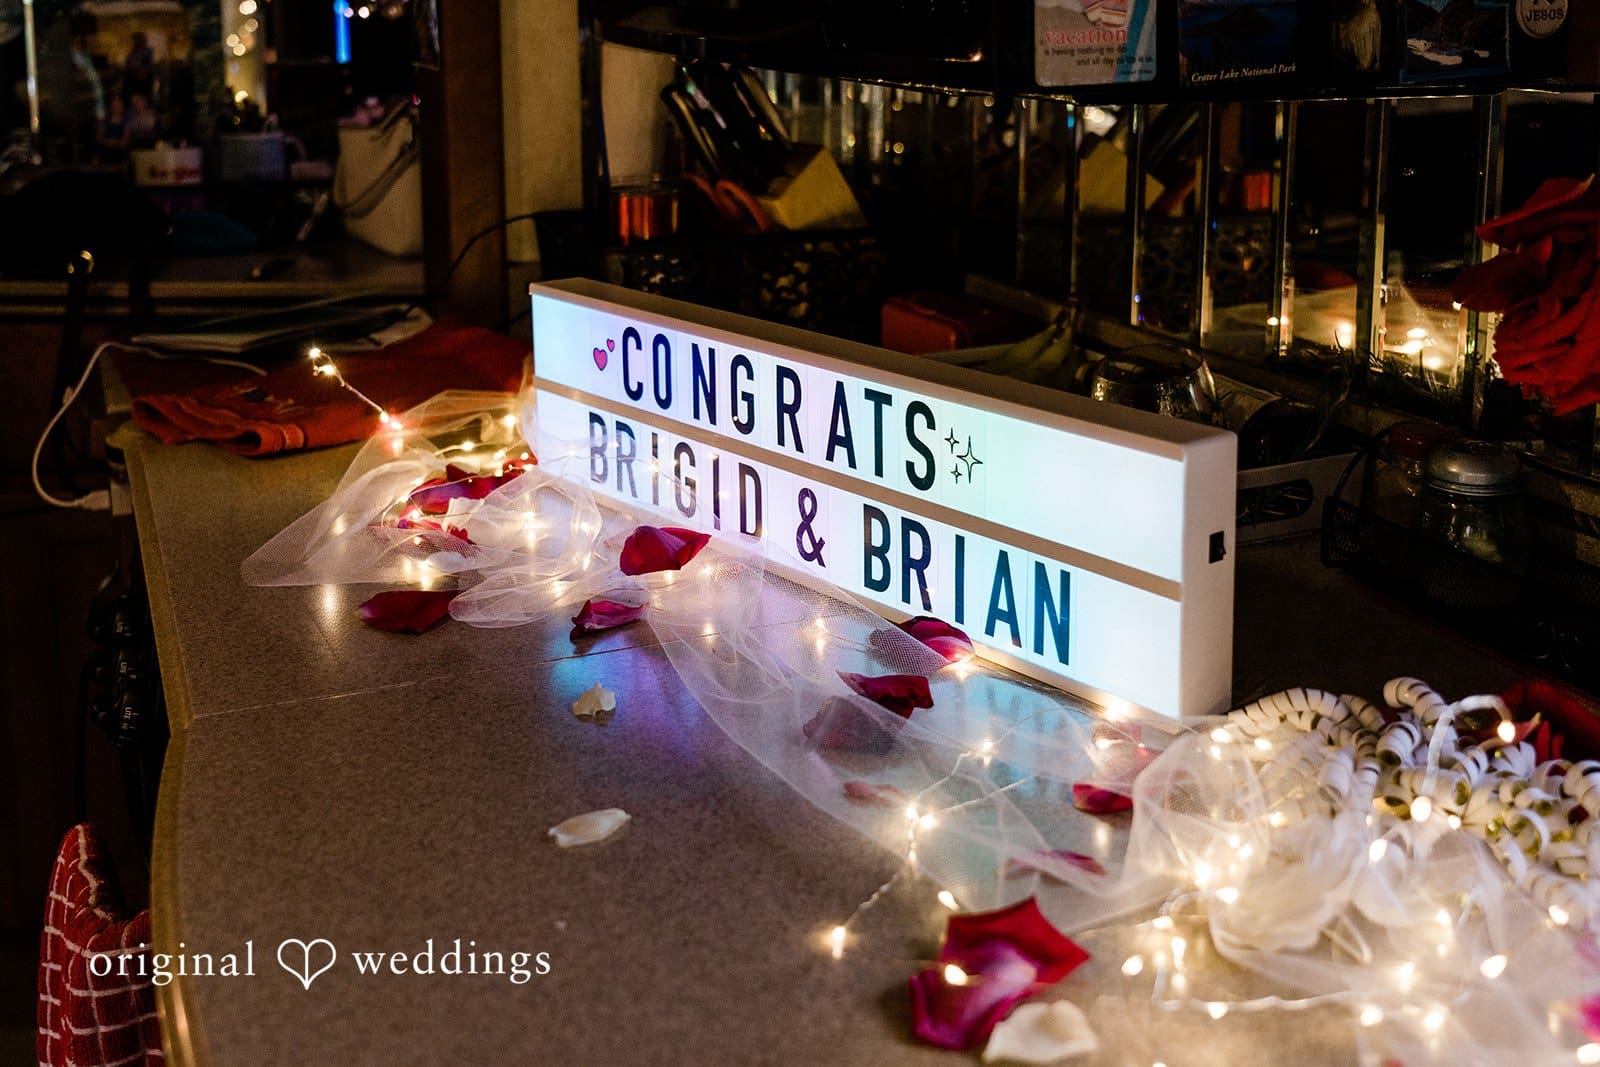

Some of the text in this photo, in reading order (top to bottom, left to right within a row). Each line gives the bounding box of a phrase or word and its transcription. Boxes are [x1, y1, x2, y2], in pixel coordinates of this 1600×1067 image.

[1045, 28, 1127, 45] vacation
[1191, 62, 1296, 83] Crater Lake National Park
[622, 326, 936, 491] CONGRATS
[588, 412, 1071, 666] BRIGID & BRIAN
